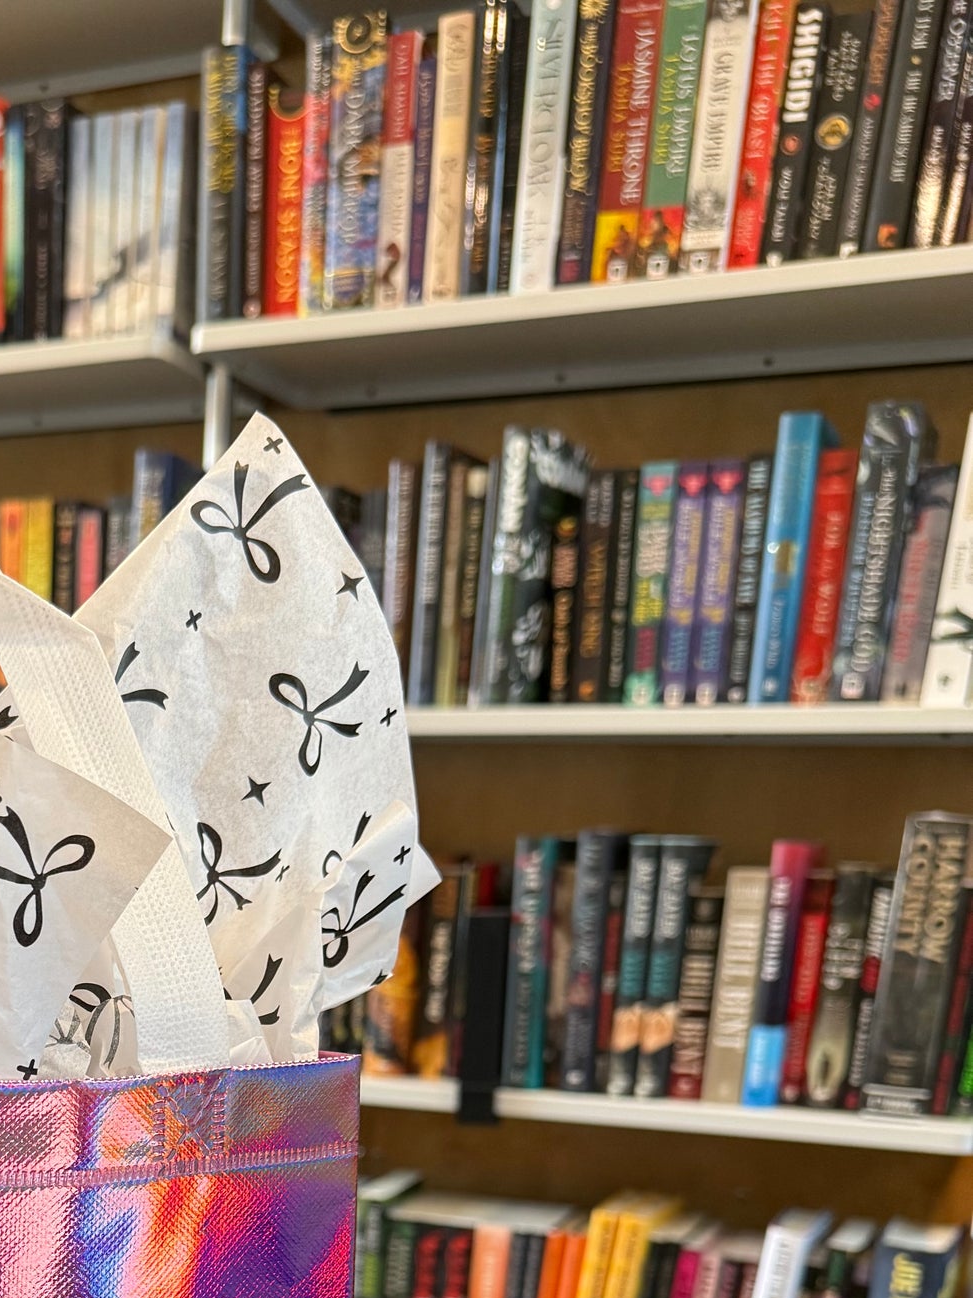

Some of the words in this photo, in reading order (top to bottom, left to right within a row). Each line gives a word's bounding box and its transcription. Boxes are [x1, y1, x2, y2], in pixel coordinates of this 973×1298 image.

[573, 42, 599, 136] BOOKSHOP
[613, 62, 634, 125] TASHA
[630, 28, 657, 112] JASMINE
[658, 53, 679, 117] TASHA
[677, 33, 701, 100] LOTUS
[708, 52, 734, 108] GRAVE
[782, 8, 824, 123] SHIGIDI
[936, 17, 966, 103] OBSERVER
[341, 91, 366, 153] DARK
[526, 18, 566, 199] SILVERCLOAK
[652, 122, 674, 166] SURI
[666, 106, 693, 179] EMPIRE
[700, 113, 730, 174] EMPIRE
[277, 137, 303, 202] BONE
[608, 131, 627, 173] SURI
[619, 116, 646, 206] THRONE
[338, 157, 362, 246] MIRROR
[275, 207, 301, 304] SEASON
[857, 492, 898, 623] NIGHTSHADE
[849, 623, 875, 673] GOD
[893, 832, 933, 957] COUNTY
[922, 836, 965, 965] HARROW
[889, 1253, 924, 1295] JOE
